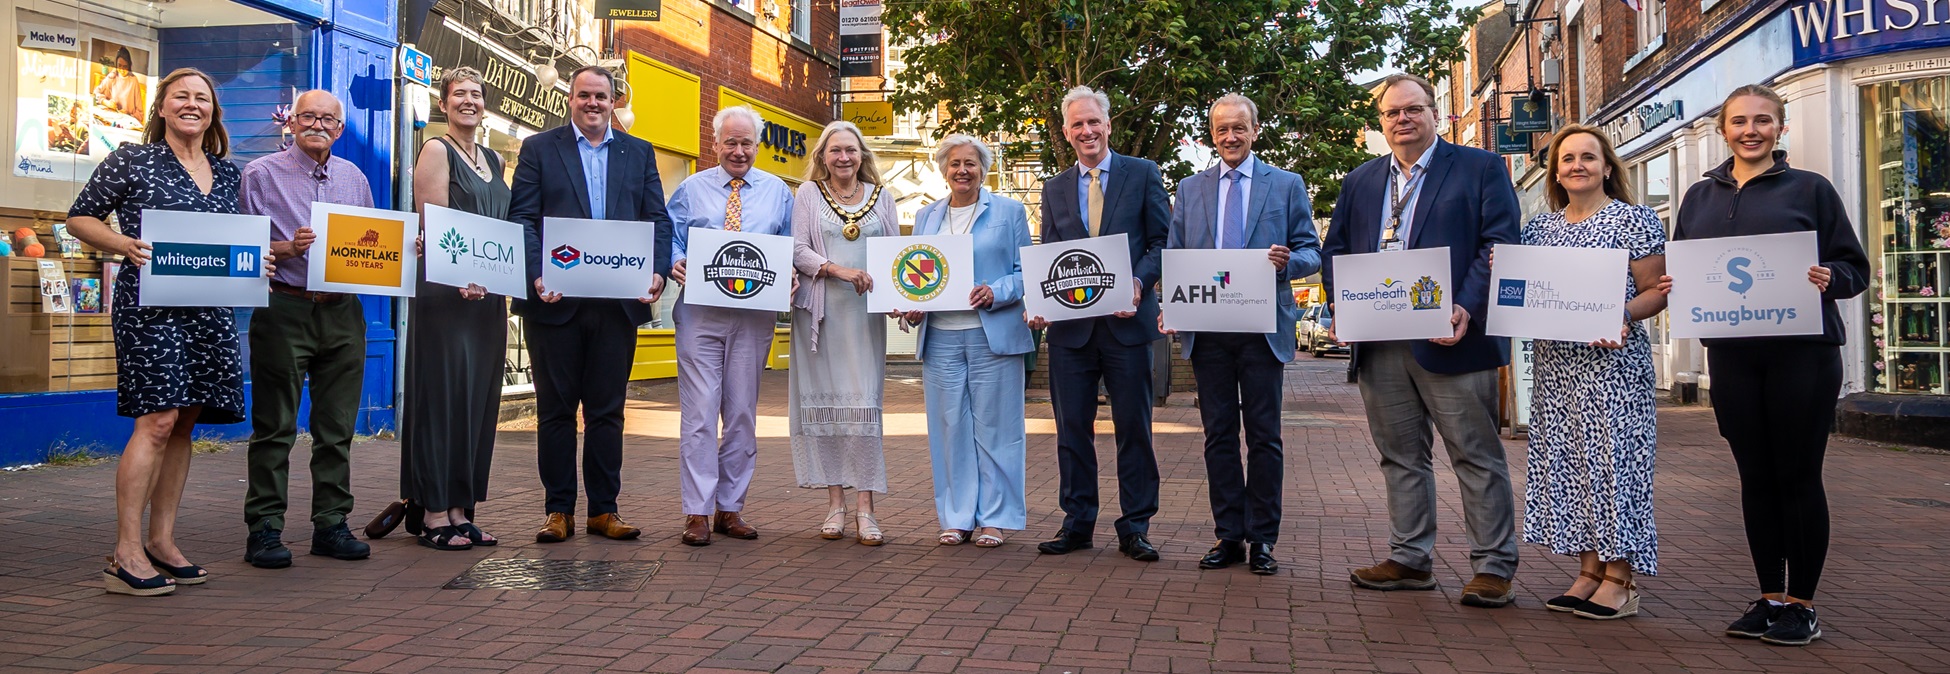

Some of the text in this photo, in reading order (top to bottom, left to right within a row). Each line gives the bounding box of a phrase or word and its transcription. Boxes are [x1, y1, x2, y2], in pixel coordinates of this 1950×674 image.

[608, 9, 658, 18] JEWELLERS
[30, 31, 76, 46] Make May
[484, 56, 569, 118] DAVID JAMES
[500, 96, 546, 128] JEWELLERS
[850, 107, 887, 124] joules
[763, 121, 807, 156] OULES
[30, 163, 53, 174] mind
[330, 246, 399, 262] MORNFLAKE
[472, 237, 515, 265] LCM
[897, 244, 943, 261] NANTWICH
[156, 252, 227, 270] whitegates
[345, 259, 384, 270] 350 YEARS
[473, 259, 515, 276] FAMILY
[583, 251, 646, 270] boughey
[722, 253, 762, 269] Nantwich
[720, 268, 761, 280] FOOD FESTIVAL
[1057, 262, 1099, 279] Nantwich
[893, 273, 948, 301] TOWN COUNCIL
[1058, 276, 1100, 289] FOOD FESTIVAL
[1527, 280, 1554, 291] HALL
[1170, 285, 1217, 304] AFH
[1341, 285, 1407, 301] Reaseheath
[1500, 286, 1524, 296] HSW
[1526, 289, 1560, 300] SMITH
[1219, 298, 1268, 306] management
[1373, 300, 1408, 312] College
[1526, 299, 1603, 313] WHITTINGHAM
[1691, 304, 1798, 327] Snugburys
